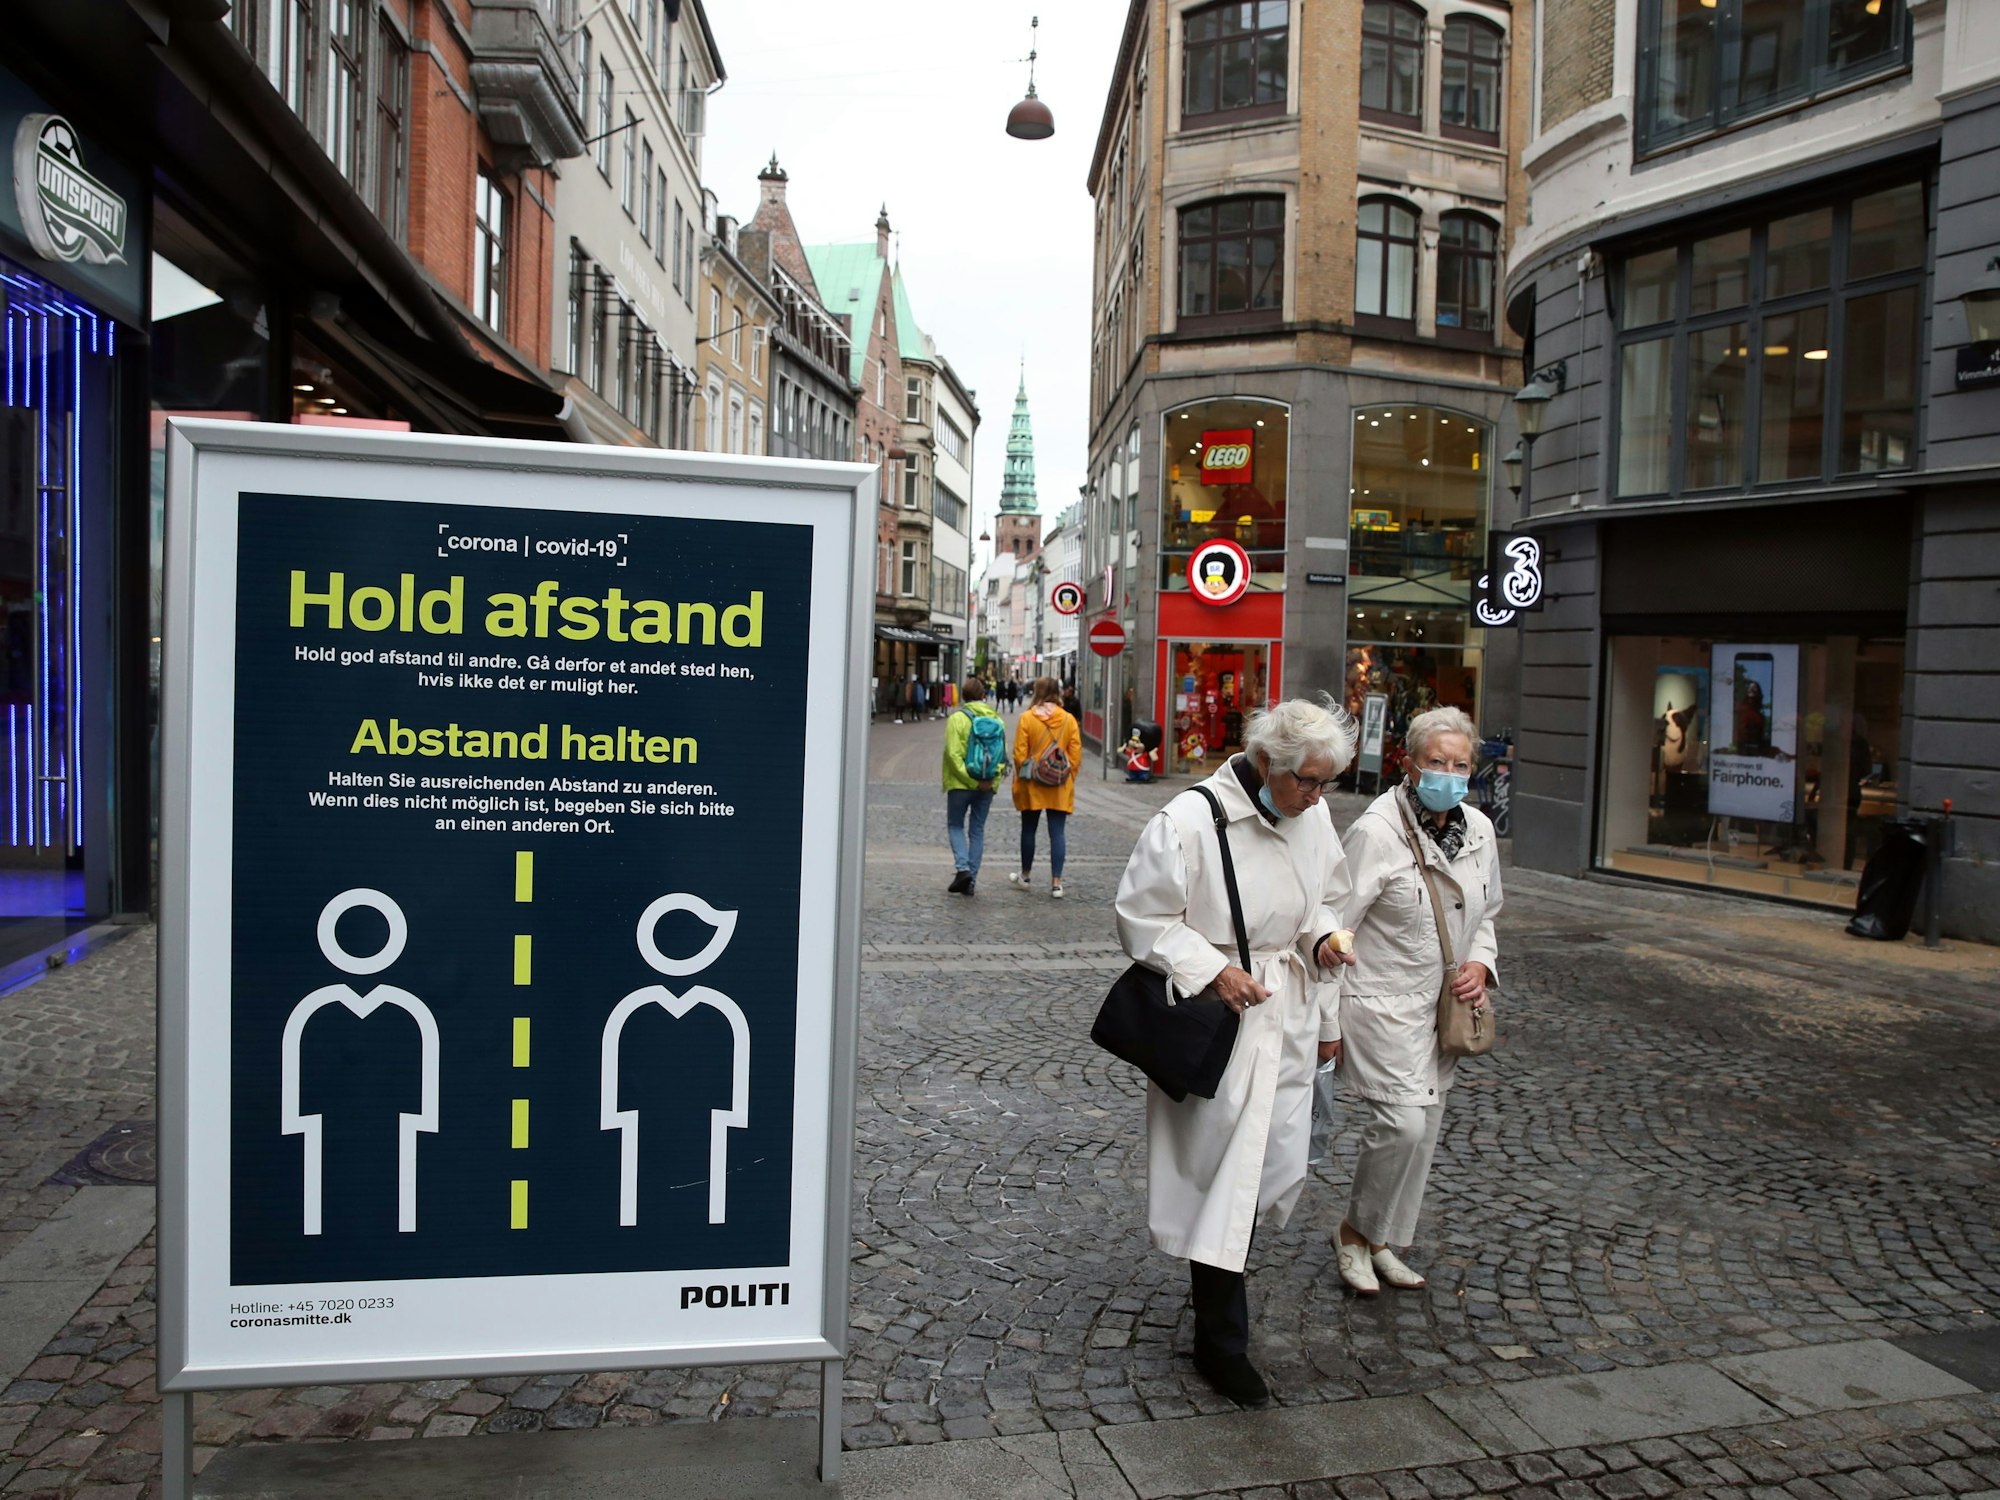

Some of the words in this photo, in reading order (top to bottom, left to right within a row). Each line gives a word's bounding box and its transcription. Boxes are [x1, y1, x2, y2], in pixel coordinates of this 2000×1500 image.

[38, 157, 123, 236] UNISPORT
[1206, 446, 1248, 467] LEGO
[447, 535, 518, 553] corona
[535, 538, 618, 558] covid-19
[1209, 564, 1221, 573] BR
[1503, 537, 1542, 607] 3
[289, 570, 465, 635] Hold
[484, 580, 764, 648] afstand
[295, 645, 336, 662] Hold
[340, 648, 374, 666] god
[378, 649, 443, 666] afstand
[447, 652, 464, 667] til
[468, 653, 522, 669] andre.
[526, 654, 550, 671] Gå
[554, 656, 607, 673] derfor
[609, 659, 626, 674] et
[629, 660, 677, 676] andet
[680, 662, 716, 677] sted
[720, 663, 755, 681] hen,
[418, 671, 454, 688] hvis
[459, 673, 494, 689] ikke
[498, 674, 526, 690] det
[529, 679, 547, 691] er
[550, 677, 604, 696] muligt
[608, 678, 639, 694] her.
[349, 718, 549, 760] Abstand
[561, 724, 698, 764] halten
[328, 771, 384, 787] Halten
[388, 772, 416, 788] Sie
[420, 774, 545, 792] ausreichenden
[548, 777, 619, 794] Abstand
[622, 782, 643, 794] zu
[646, 780, 718, 796] anderen.
[1712, 769, 1784, 788] Fairphone.
[308, 791, 358, 808] Wenn
[363, 793, 400, 809] dies
[404, 794, 448, 810] nicht
[451, 795, 520, 814] möglich
[524, 797, 550, 814] ist,
[554, 797, 626, 816] begeben
[629, 799, 656, 815] Sie
[659, 800, 695, 816] sich
[699, 801, 735, 817] bitte
[434, 818, 456, 830] an
[460, 816, 507, 832] einen
[511, 817, 580, 833] anderen
[584, 818, 615, 834] Ort.
[230, 1302, 283, 1314] Hotline:
[287, 1300, 314, 1312] +45
[318, 1298, 355, 1311] 7020
[358, 1297, 395, 1310] 0233
[680, 1282, 790, 1310] POLITI
[230, 1312, 352, 1329] coronasmitte.dk
